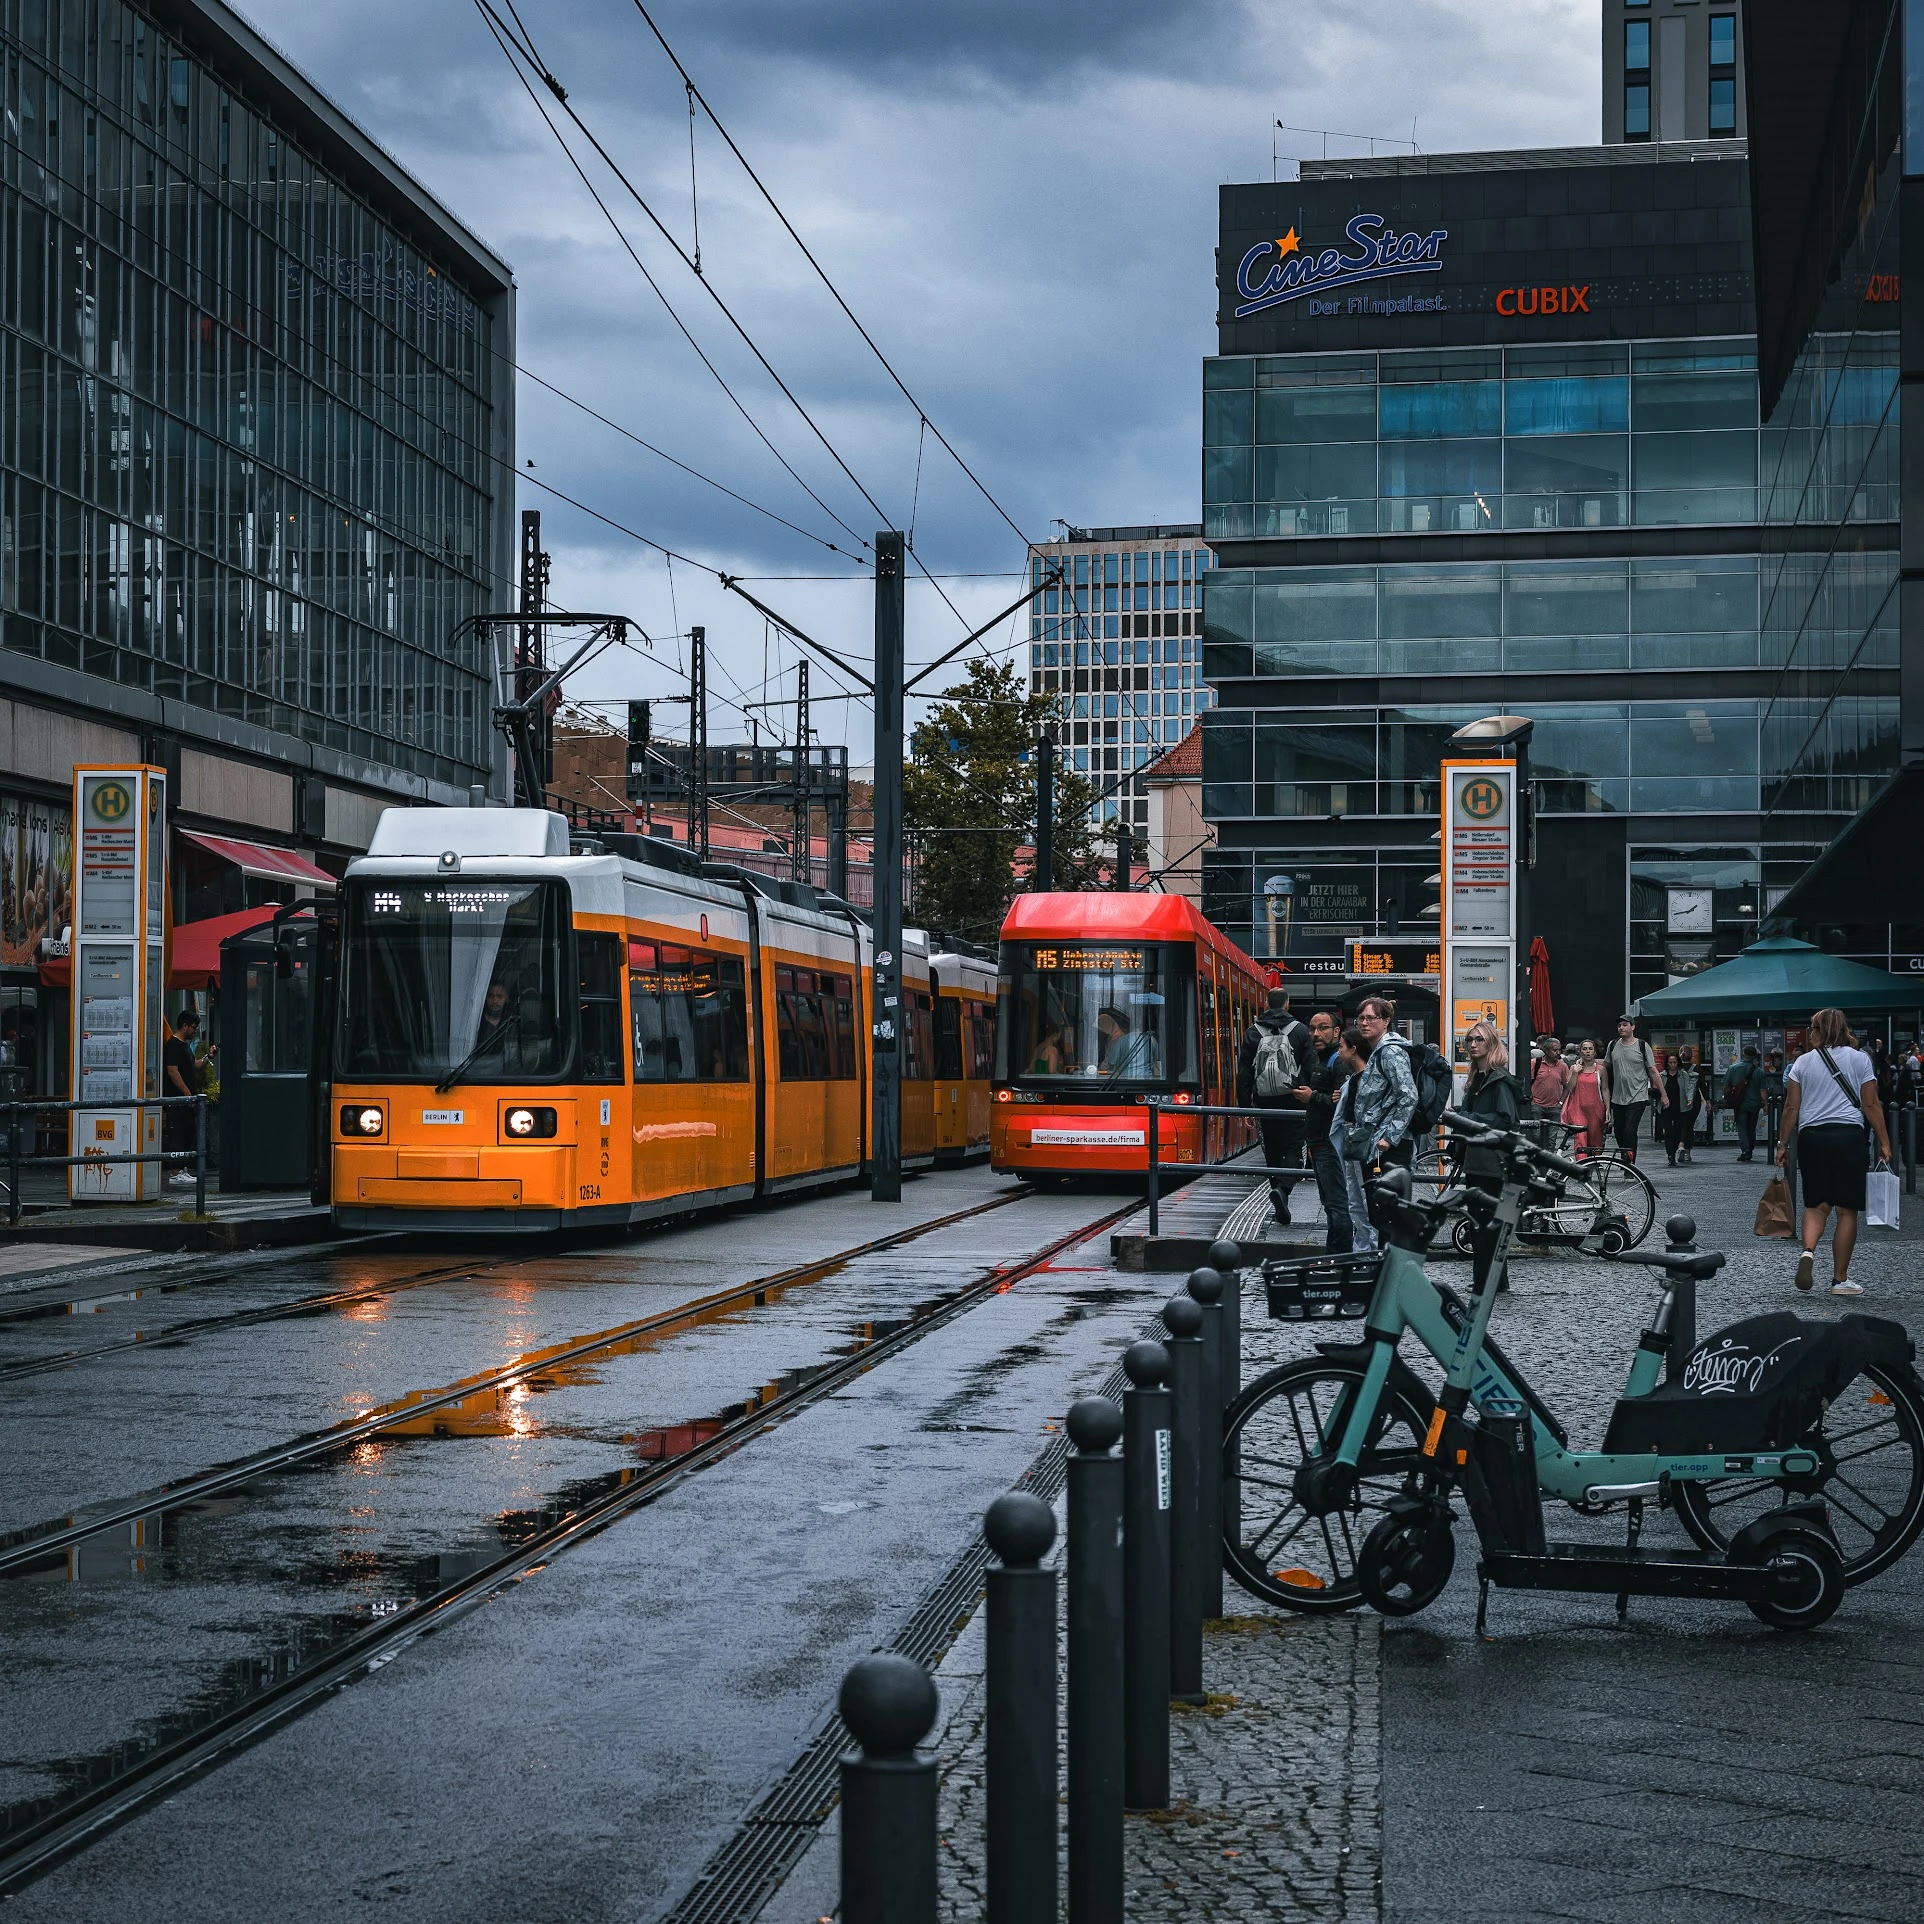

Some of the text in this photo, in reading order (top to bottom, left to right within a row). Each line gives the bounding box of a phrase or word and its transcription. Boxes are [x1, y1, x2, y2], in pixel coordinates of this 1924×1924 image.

[1236, 213, 1448, 301] CineStar
[1309, 298, 1341, 316] Der
[1495, 286, 1590, 316] CUBIX
[1308, 884, 1359, 896] JETZT HIER
[374, 892, 401, 912] M4
[1300, 896, 1368, 908] IN DER CARAMBAR
[1309, 908, 1357, 920] ERFRISCHEN!
[1036, 949, 1057, 969] M5
[1120, 959, 1144, 969] Str.
[1716, 1035, 1736, 1045] BAR
[423, 1113, 448, 1121] BERLIN
[97, 1129, 113, 1139] BVG
[1035, 1133, 1140, 1145] berliner-sparkasse.de/firma
[579, 1184, 601, 1200] 1263-A
[1302, 1289, 1342, 1300] tier.app
[1515, 1422, 1525, 1453] TIER
[1159, 1431, 1169, 1508] RAPID WIEN
[1669, 1462, 1708, 1474] tier.app
